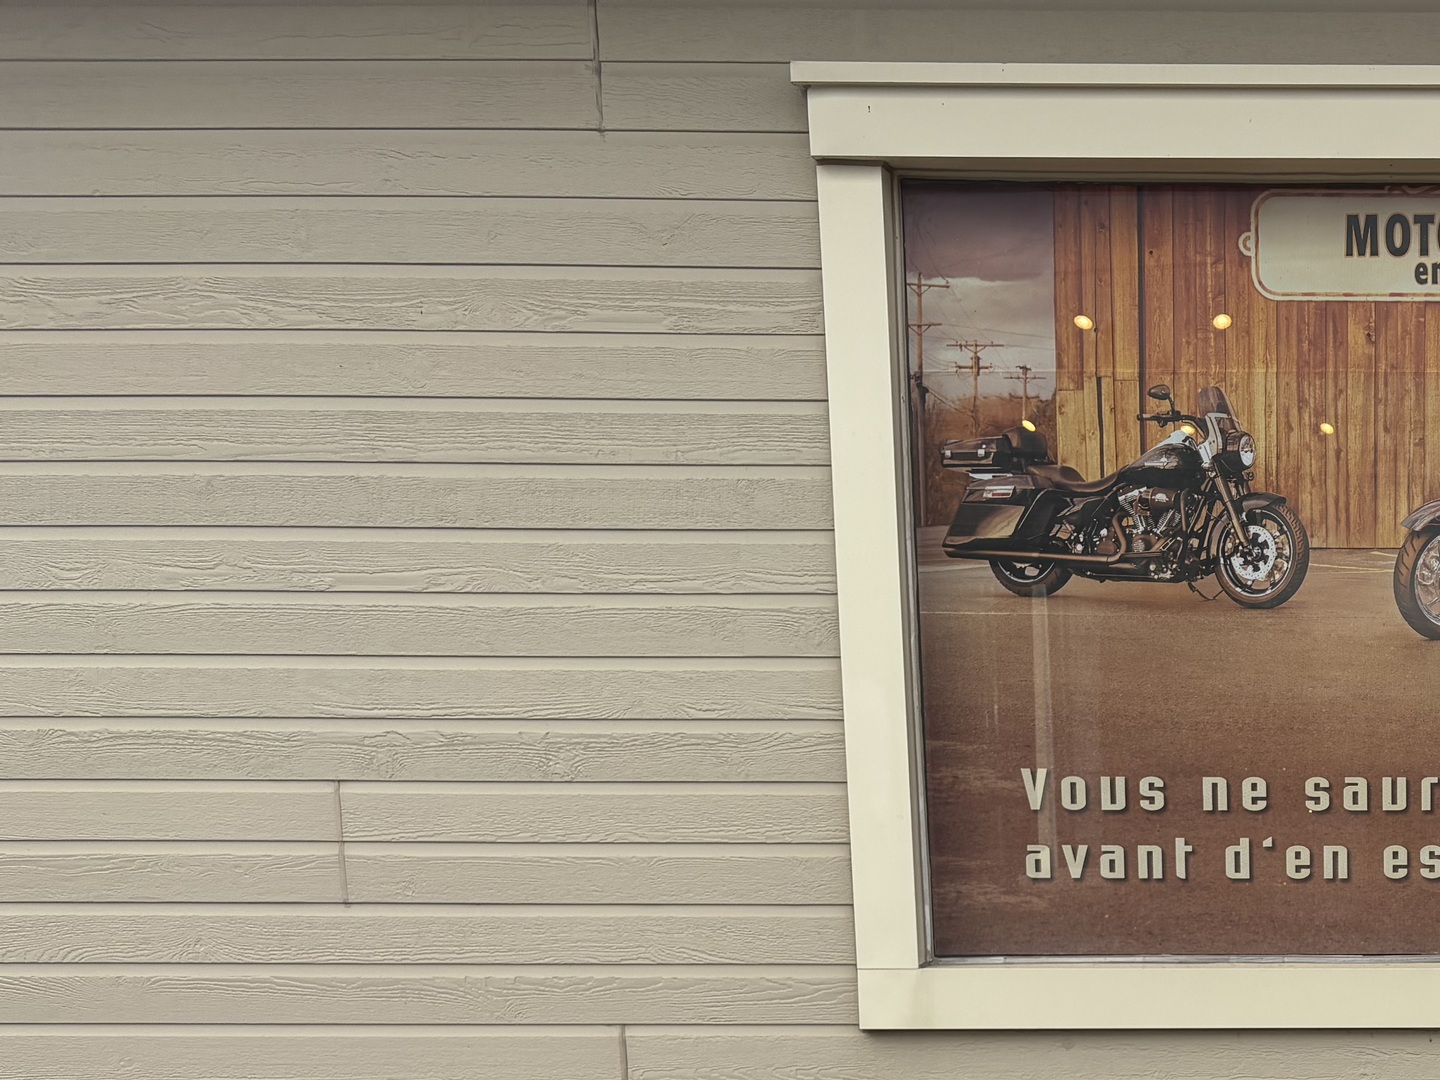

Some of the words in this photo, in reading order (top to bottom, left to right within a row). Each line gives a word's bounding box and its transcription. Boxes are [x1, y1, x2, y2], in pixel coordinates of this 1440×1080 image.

[1020, 767, 1166, 812] Vous
[1202, 775, 1268, 812] ne
[1025, 837, 1194, 880] avant
